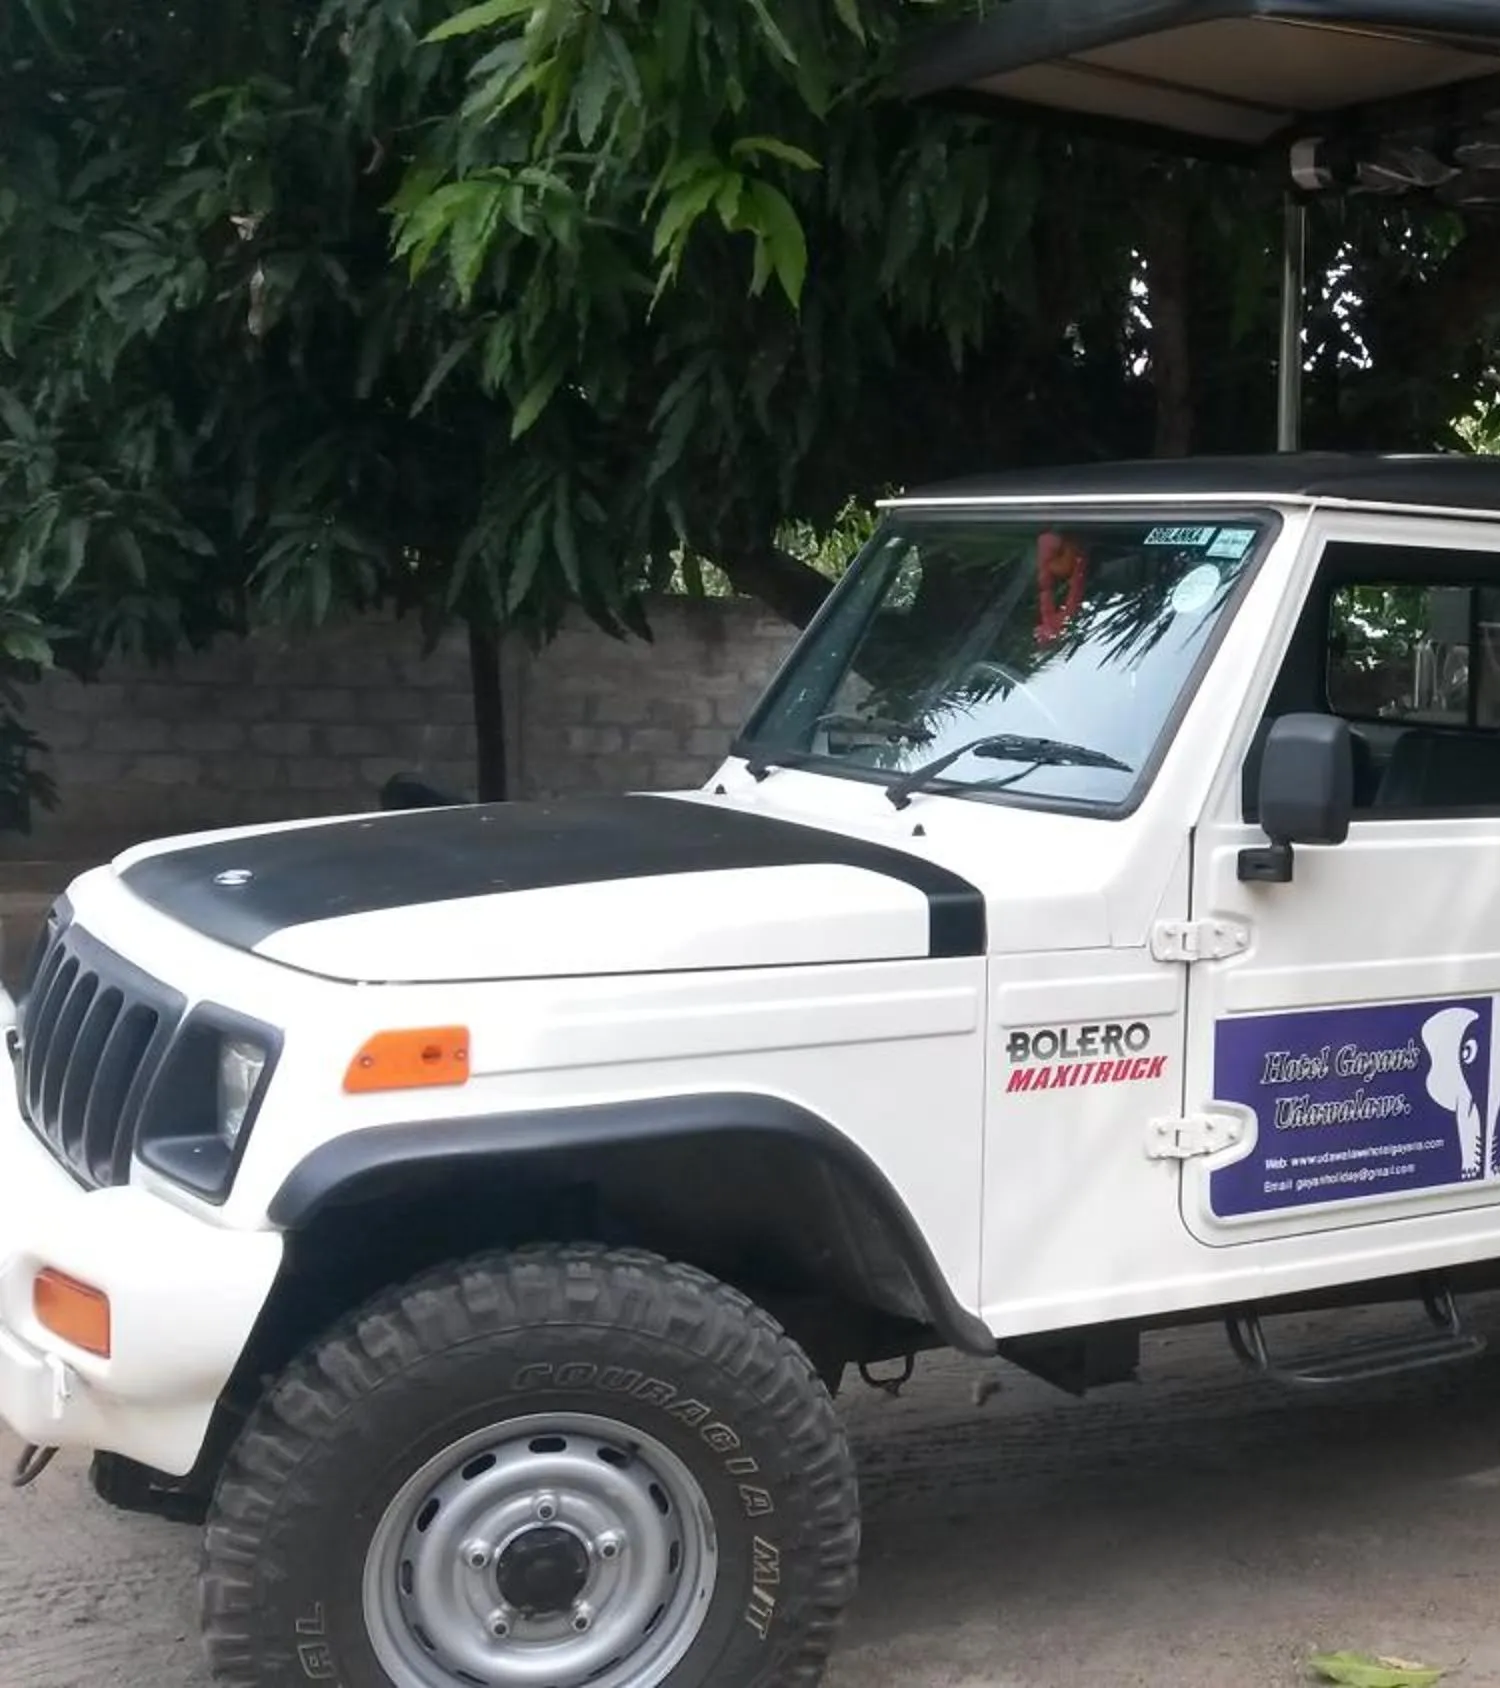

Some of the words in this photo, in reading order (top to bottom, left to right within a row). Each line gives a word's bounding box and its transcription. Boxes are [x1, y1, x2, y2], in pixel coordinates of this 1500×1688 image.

[1005, 1021, 1150, 1062] BOLERO
[1260, 1045, 1331, 1084] Hotel
[1335, 1037, 1420, 1083] Gayan's
[1005, 1055, 1168, 1093] MAXITRUCK
[1274, 1088, 1412, 1130] Udawalawe.
[513, 1361, 774, 1517] COURAGIA
[745, 1535, 780, 1640] M/T
